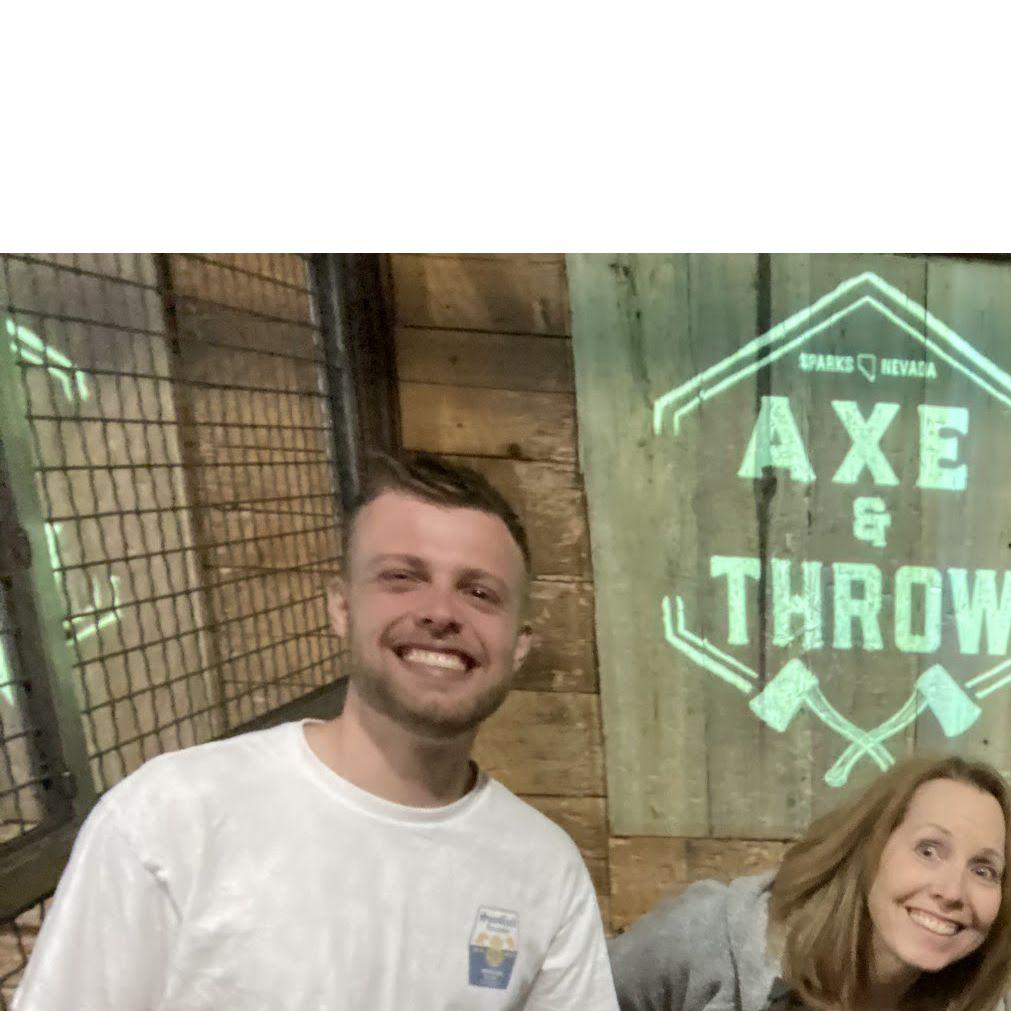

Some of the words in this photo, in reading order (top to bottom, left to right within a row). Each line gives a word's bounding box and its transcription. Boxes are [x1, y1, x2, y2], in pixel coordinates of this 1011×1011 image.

[799, 352, 854, 373] SPARKS
[880, 358, 937, 379] NEVADA
[737, 396, 969, 490] AXE
[853, 497, 892, 547] &
